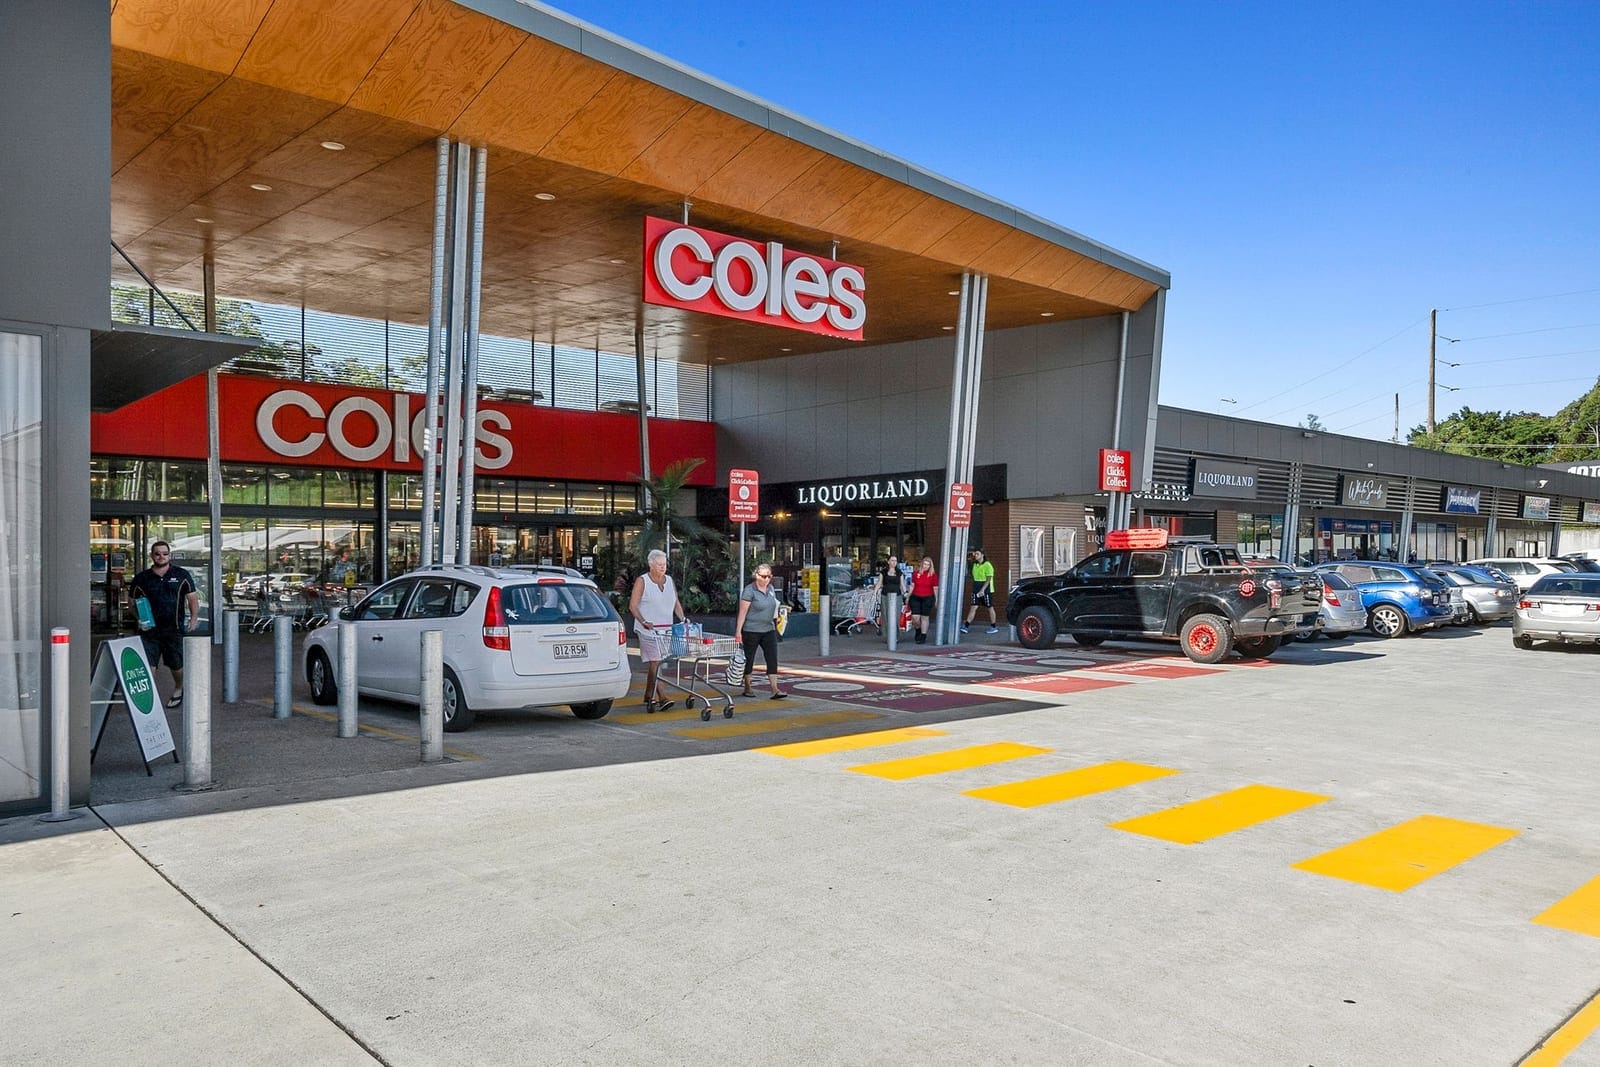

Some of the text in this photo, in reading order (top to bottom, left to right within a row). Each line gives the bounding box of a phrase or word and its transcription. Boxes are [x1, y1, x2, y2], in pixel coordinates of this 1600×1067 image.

[654, 228, 866, 330] coles
[1106, 454, 1125, 464] coles
[1106, 477, 1127, 487] Collect
[1198, 472, 1255, 487] LIQUORLAND
[798, 479, 930, 507] LIQUORLAND
[135, 667, 146, 677] THE
[129, 678, 150, 695] A-LIST
